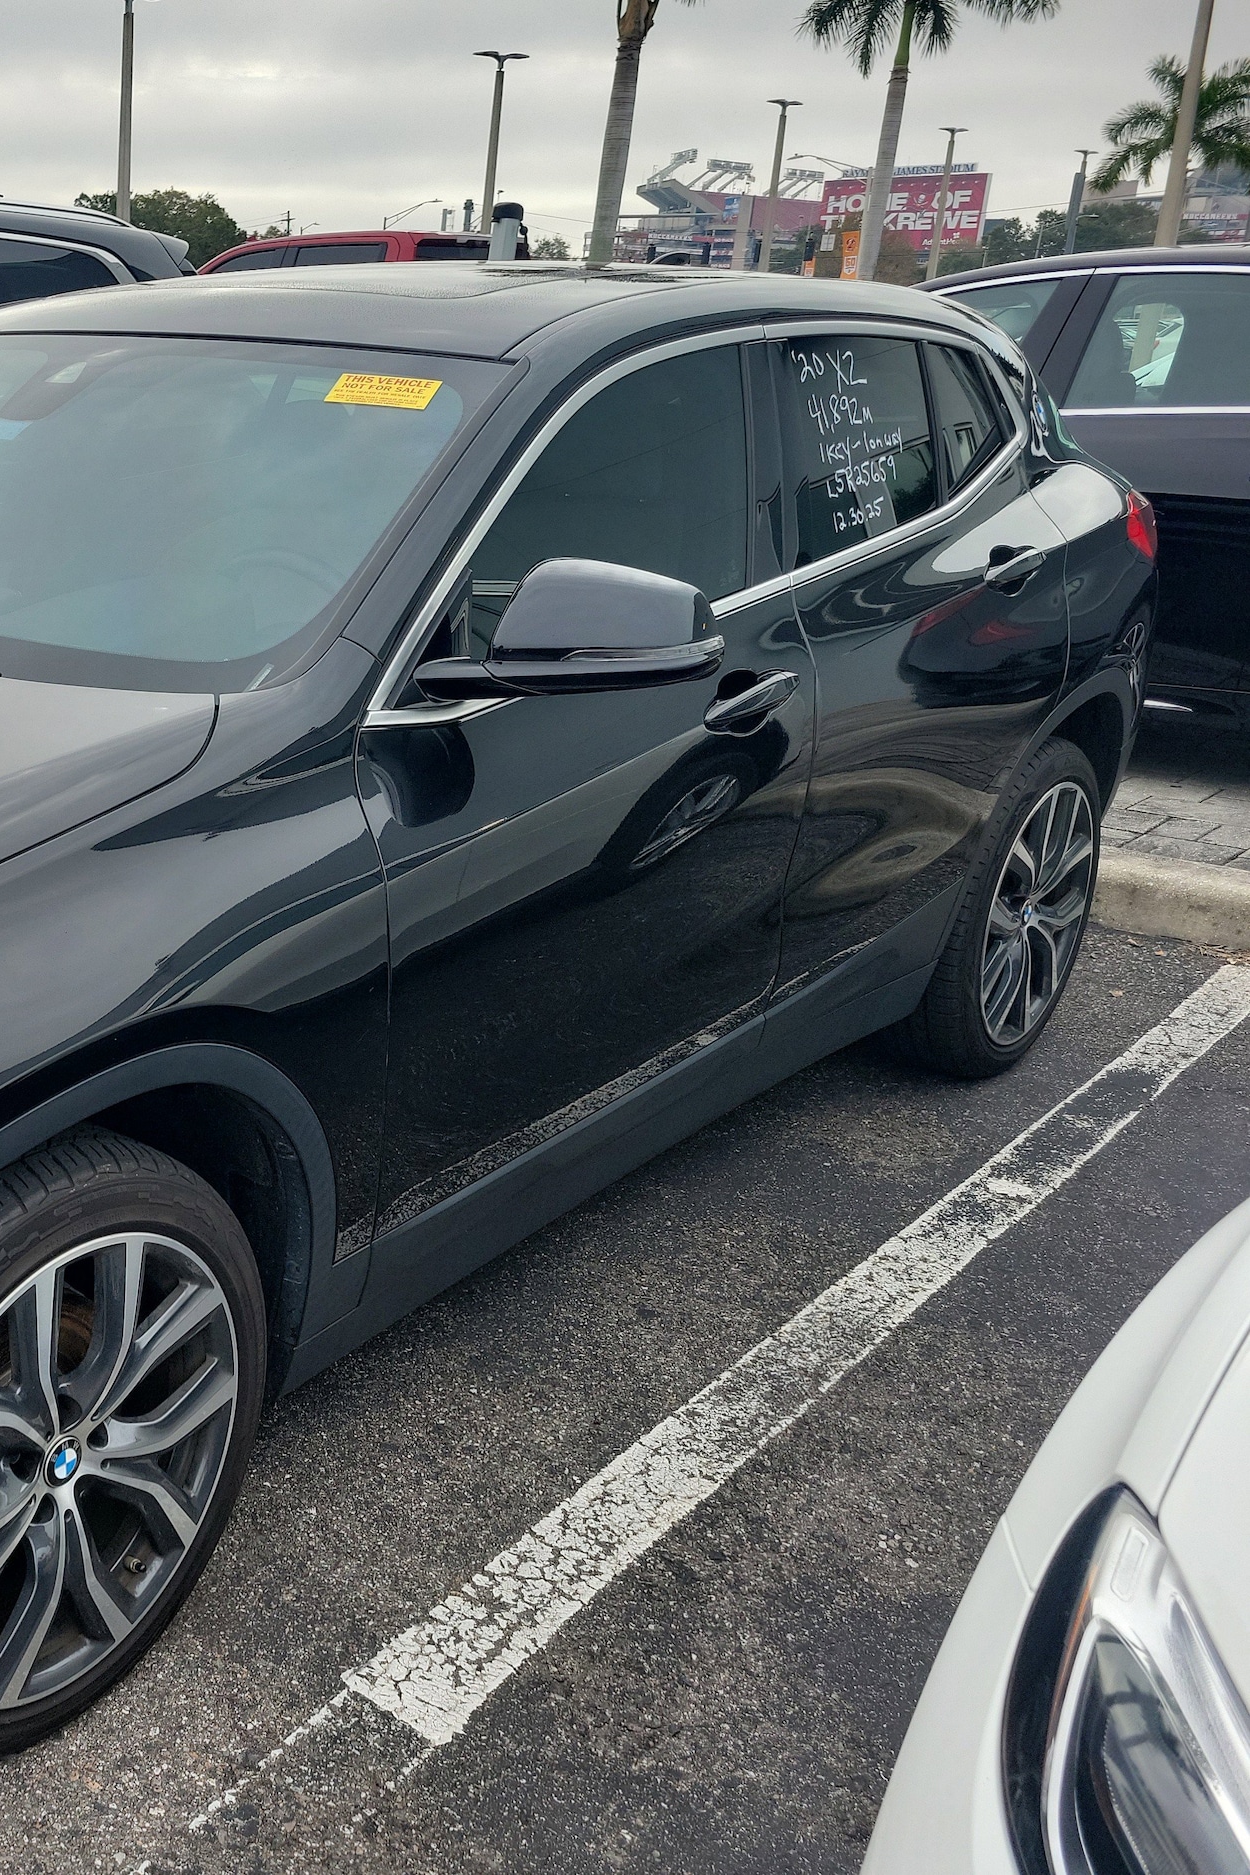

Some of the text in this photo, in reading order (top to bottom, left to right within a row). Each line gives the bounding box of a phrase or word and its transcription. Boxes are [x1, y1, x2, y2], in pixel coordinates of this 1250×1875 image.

[893, 165, 929, 176] JAMES
[931, 189, 973, 210] OF
[826, 349, 868, 394] X2
[341, 382, 426, 395] NOT FOR SALE
[344, 375, 435, 389] THIS VEHICLE
[832, 496, 885, 533] 12.30.25
